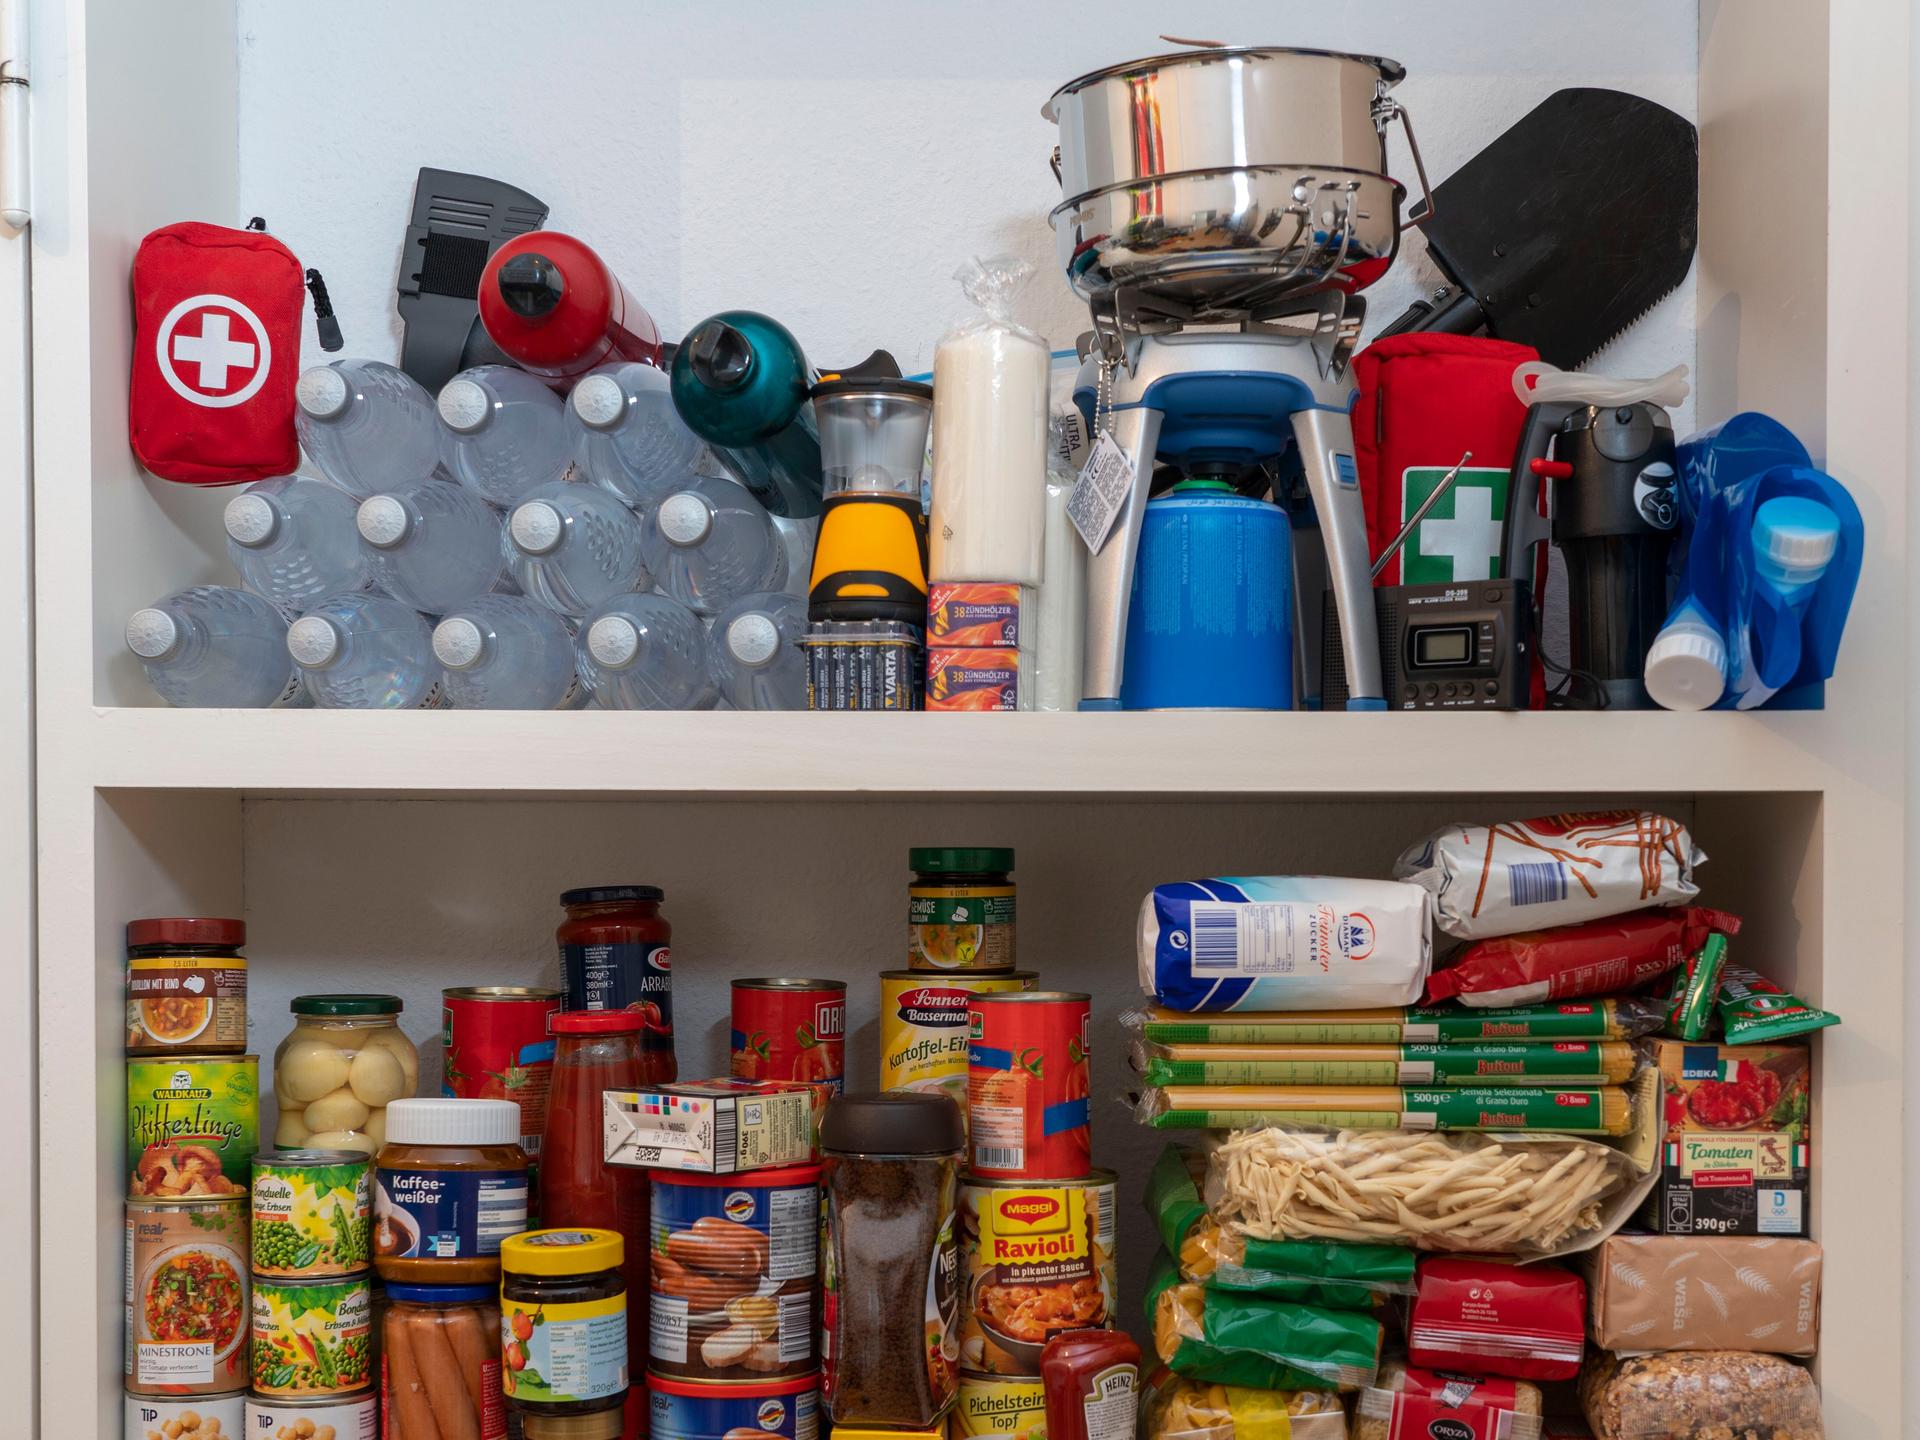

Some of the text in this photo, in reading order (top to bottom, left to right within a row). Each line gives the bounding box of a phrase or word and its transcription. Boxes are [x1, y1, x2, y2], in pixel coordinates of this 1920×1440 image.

[954, 605, 1011, 618] 38 ZÜNDHÖLZER
[816, 647, 823, 659] AA
[832, 647, 838, 659] AA
[859, 647, 865, 659] AA
[886, 650, 896, 696] VARTA
[953, 670, 1010, 683] 38 ZÜNDHÖLZER
[912, 899, 936, 914] GEMÜSE
[1310, 914, 1318, 962] ZUCKER
[1317, 904, 1336, 973] Feinster
[152, 978, 162, 989] MIT
[164, 978, 179, 989] RIND
[1482, 1021, 1529, 1037] Buitoni
[1477, 1059, 1525, 1075] Buitoni
[1682, 1070, 1718, 1078] EDEKA
[155, 1090, 208, 1099] WALDKAUZ
[1460, 1088, 1542, 1097] Semola Selezionata
[1476, 1097, 1483, 1105] di
[1485, 1097, 1509, 1105] Grano
[1478, 1111, 1526, 1126] Buitoni
[132, 1103, 242, 1151] Pfifferlinge
[1686, 1143, 1753, 1160] Tomaten
[393, 1176, 446, 1190] Kaffee-
[395, 1190, 442, 1204] weißer
[266, 1204, 292, 1212] Erbsen
[994, 1234, 1074, 1258] Ravioli
[1021, 1265, 1058, 1278] pikanter
[1060, 1262, 1084, 1272] Sauce
[324, 1320, 351, 1330] Erbsen
[140, 1345, 211, 1358] MINESTRONE
[1105, 1375, 1131, 1392] HEINZ
[990, 1412, 1018, 1432] Topf
[1433, 1425, 1468, 1438] ORYZA
